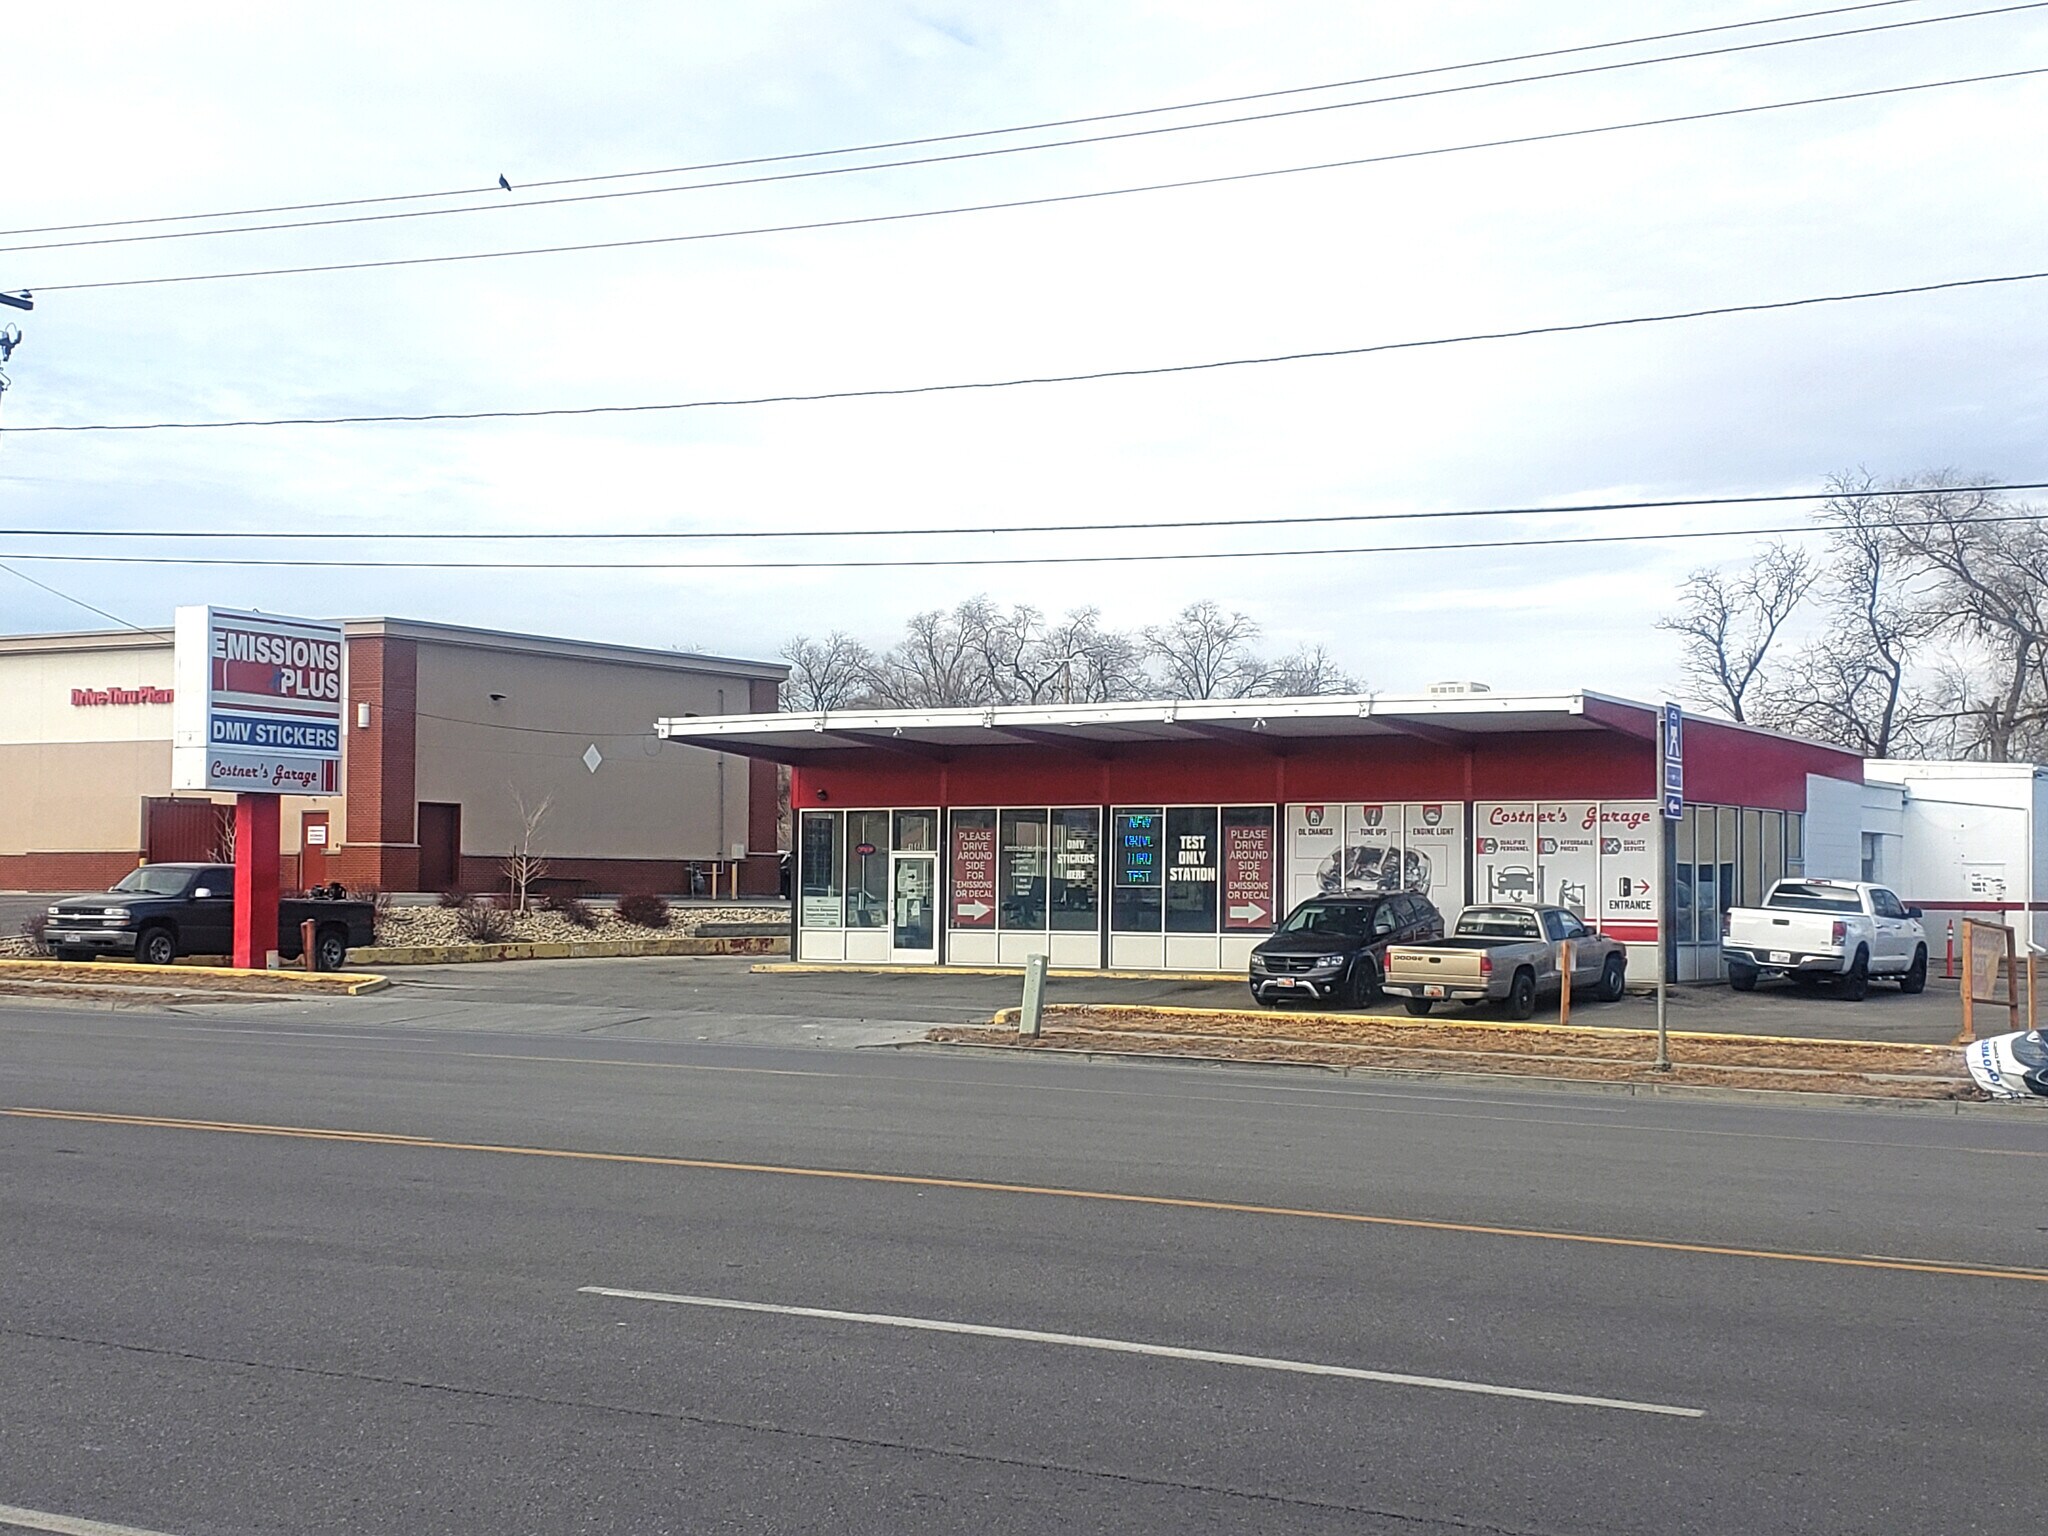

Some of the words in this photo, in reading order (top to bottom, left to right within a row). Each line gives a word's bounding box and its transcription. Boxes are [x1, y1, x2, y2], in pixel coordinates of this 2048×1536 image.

[212, 631, 339, 671] EMISSIONS
[281, 667, 339, 699] PLUS
[213, 720, 252, 741] DMV
[255, 723, 337, 748] STICKERS
[211, 760, 268, 778] Costner's
[272, 764, 317, 787] Garage
[1490, 807, 1568, 825] Costner's
[1581, 806, 1651, 830] Garage
[959, 831, 992, 841] PLEASE
[1230, 830, 1268, 839] PLEASE
[1308, 828, 1334, 836] CHANGES
[1360, 828, 1375, 836] TUNE
[1375, 828, 1387, 836] UPS
[1412, 828, 1435, 836] ENGINE
[1436, 828, 1454, 836] LIGHT
[962, 841, 989, 850] DRIVE
[1179, 835, 1206, 849] TEST
[1234, 840, 1264, 850] DRIVE
[957, 851, 993, 860] AROUND
[1057, 853, 1095, 864] STICKERS
[1178, 851, 1206, 865] ONLY
[1229, 850, 1269, 860] AROUND
[965, 861, 986, 870] SIDE
[1238, 861, 1261, 870] SIDE
[966, 871, 984, 880] FOR
[1066, 870, 1085, 880] HERE
[1169, 867, 1216, 881] STATION
[1239, 871, 1259, 880] FOR
[956, 881, 993, 889] EMISSIONS
[1228, 881, 1269, 890] EMISSIONS
[955, 889, 968, 898] OR
[969, 890, 993, 898] DECAL
[1227, 891, 1241, 899] OR
[1242, 891, 1270, 899] DECAL
[1609, 900, 1652, 910] ENTRANCE
